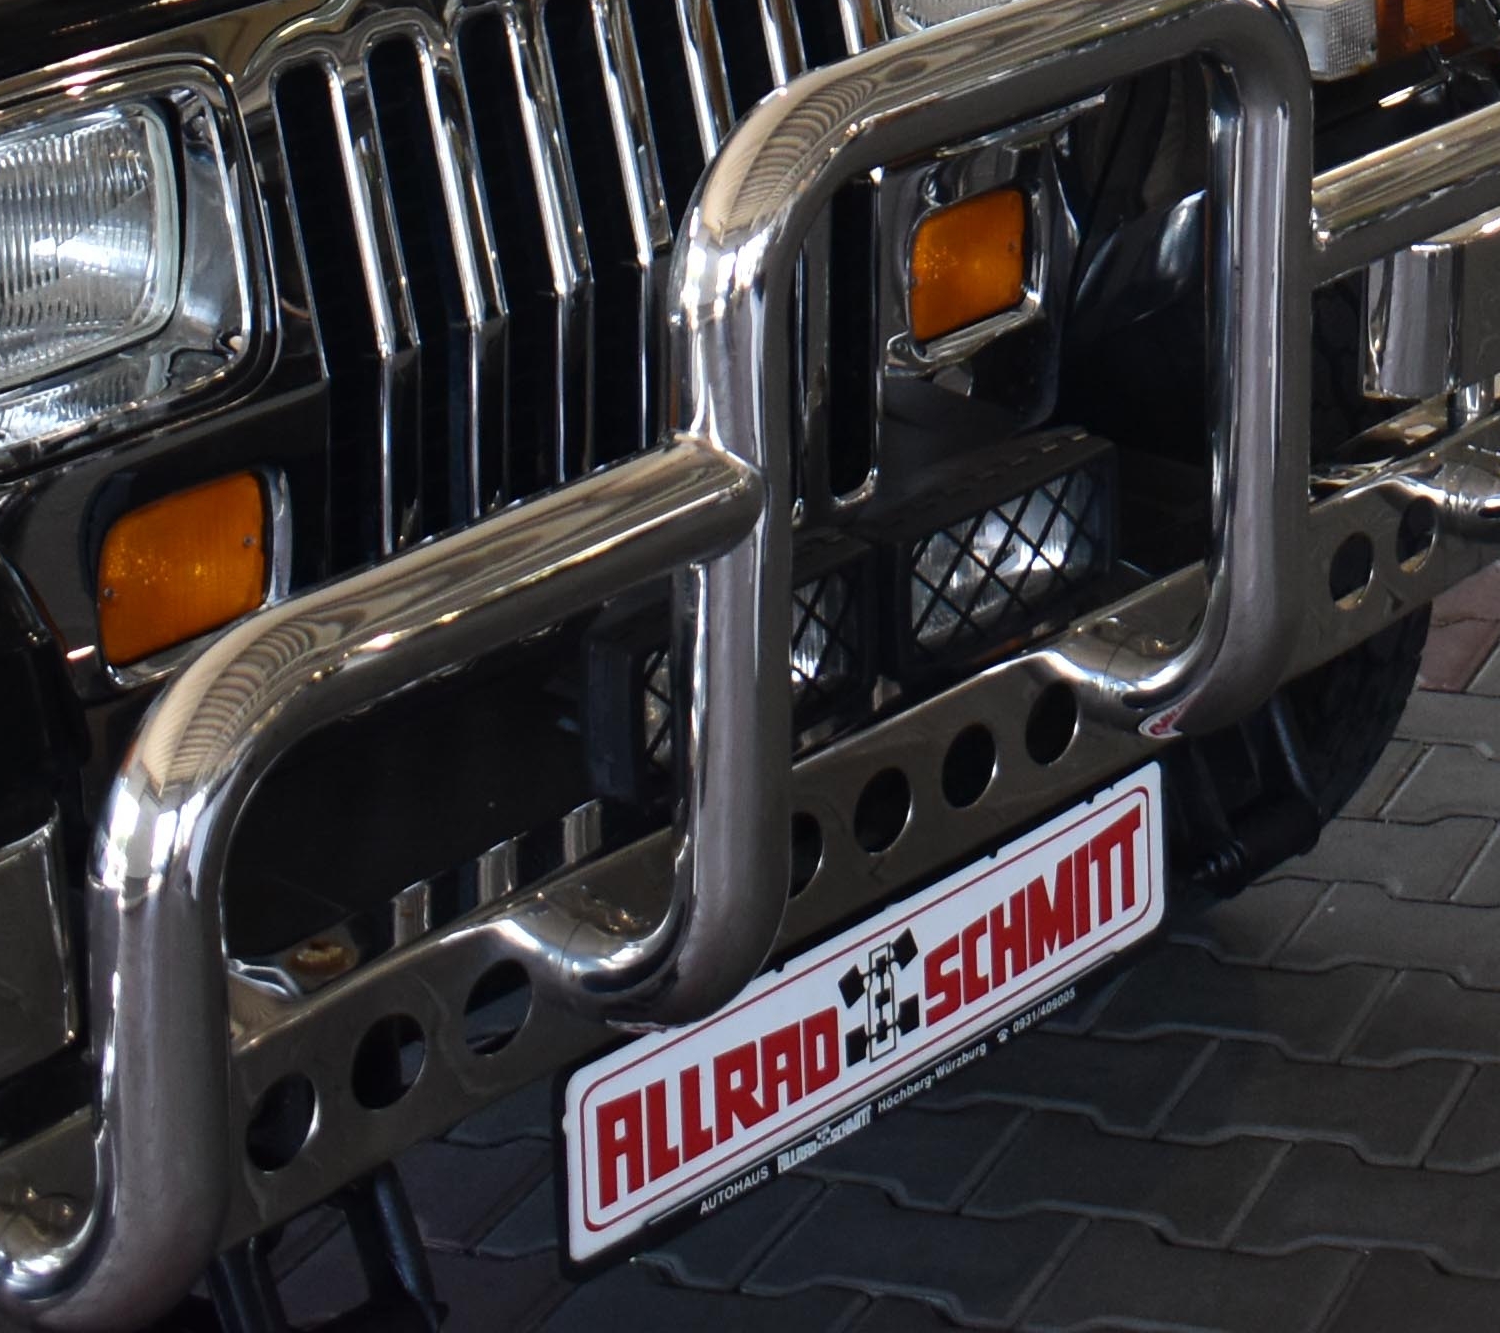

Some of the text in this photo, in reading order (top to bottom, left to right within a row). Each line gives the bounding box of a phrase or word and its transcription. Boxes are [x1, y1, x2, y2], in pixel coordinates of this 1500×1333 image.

[596, 803, 1142, 1211] ALLRAD SCHMITT
[699, 1165, 769, 1215] AUTOHAUS
[877, 1041, 987, 1114] Höchberg-Würzburg
[1012, 987, 1076, 1033] 0931/409005
